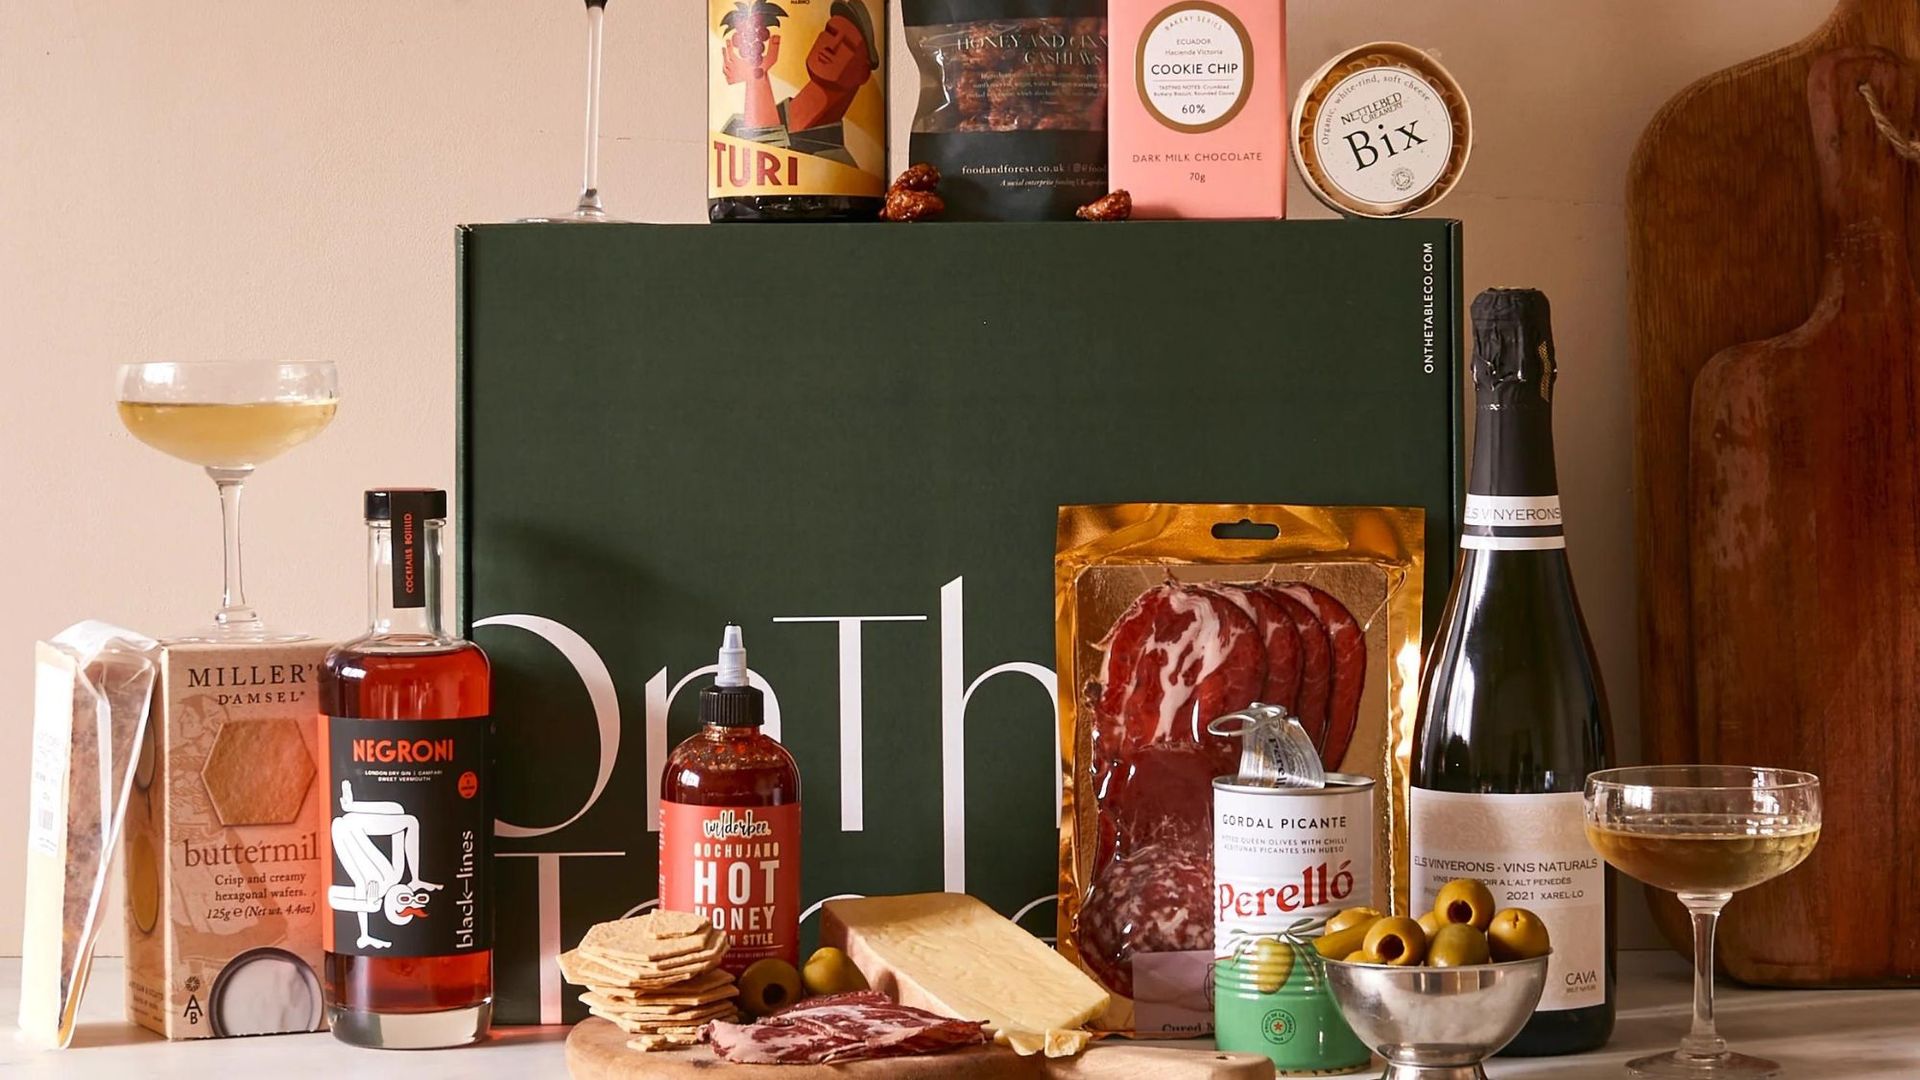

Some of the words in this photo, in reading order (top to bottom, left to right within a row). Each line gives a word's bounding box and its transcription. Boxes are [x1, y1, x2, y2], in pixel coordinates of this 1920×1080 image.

[1151, 64, 1203, 75] COOKIE
[1208, 63, 1238, 74] CHIP
[1384, 74, 1401, 83] soft
[1403, 81, 1430, 101] cheese
[1181, 104, 1206, 114] 60%
[1340, 91, 1402, 125] NETTLEBED
[1343, 119, 1429, 171] Bix
[714, 141, 798, 188] TURI
[1132, 154, 1161, 163] DARK
[1165, 153, 1190, 162] MILK
[1195, 152, 1263, 162] CHOCOLATE
[962, 163, 1063, 175] foodandforest.co.uk
[1189, 172, 1206, 183] 70g
[1423, 243, 1434, 374] ONTHETABLECO.COM
[1481, 508, 1561, 520] VINYERONS
[353, 739, 454, 763] NEGRONI
[1268, 737, 1288, 788] Perell
[1222, 814, 1274, 829] GORDAL
[1280, 816, 1347, 829] PICANTE
[1241, 837, 1266, 845] QUEEN
[1268, 838, 1298, 846] OLIVES
[1260, 846, 1299, 854] PICANTES
[1414, 856, 1428, 868] ELS
[1428, 859, 1495, 873] VINYERONS
[1503, 863, 1535, 873] VINS
[1538, 858, 1598, 872] NATURALS
[215, 874, 244, 887] Crisp
[247, 873, 266, 884] and
[269, 872, 307, 884] creamy
[694, 859, 780, 905] HOT
[215, 887, 267, 903] hexagonal
[269, 886, 307, 898] wafers.
[1219, 860, 1354, 922] Perelló
[1506, 891, 1534, 901] 2021
[207, 908, 231, 921] 125g
[244, 905, 266, 919] (Net
[285, 902, 316, 915] 4.4oz)
[742, 932, 774, 946] STYLE
[1565, 970, 1597, 985] CAVA
